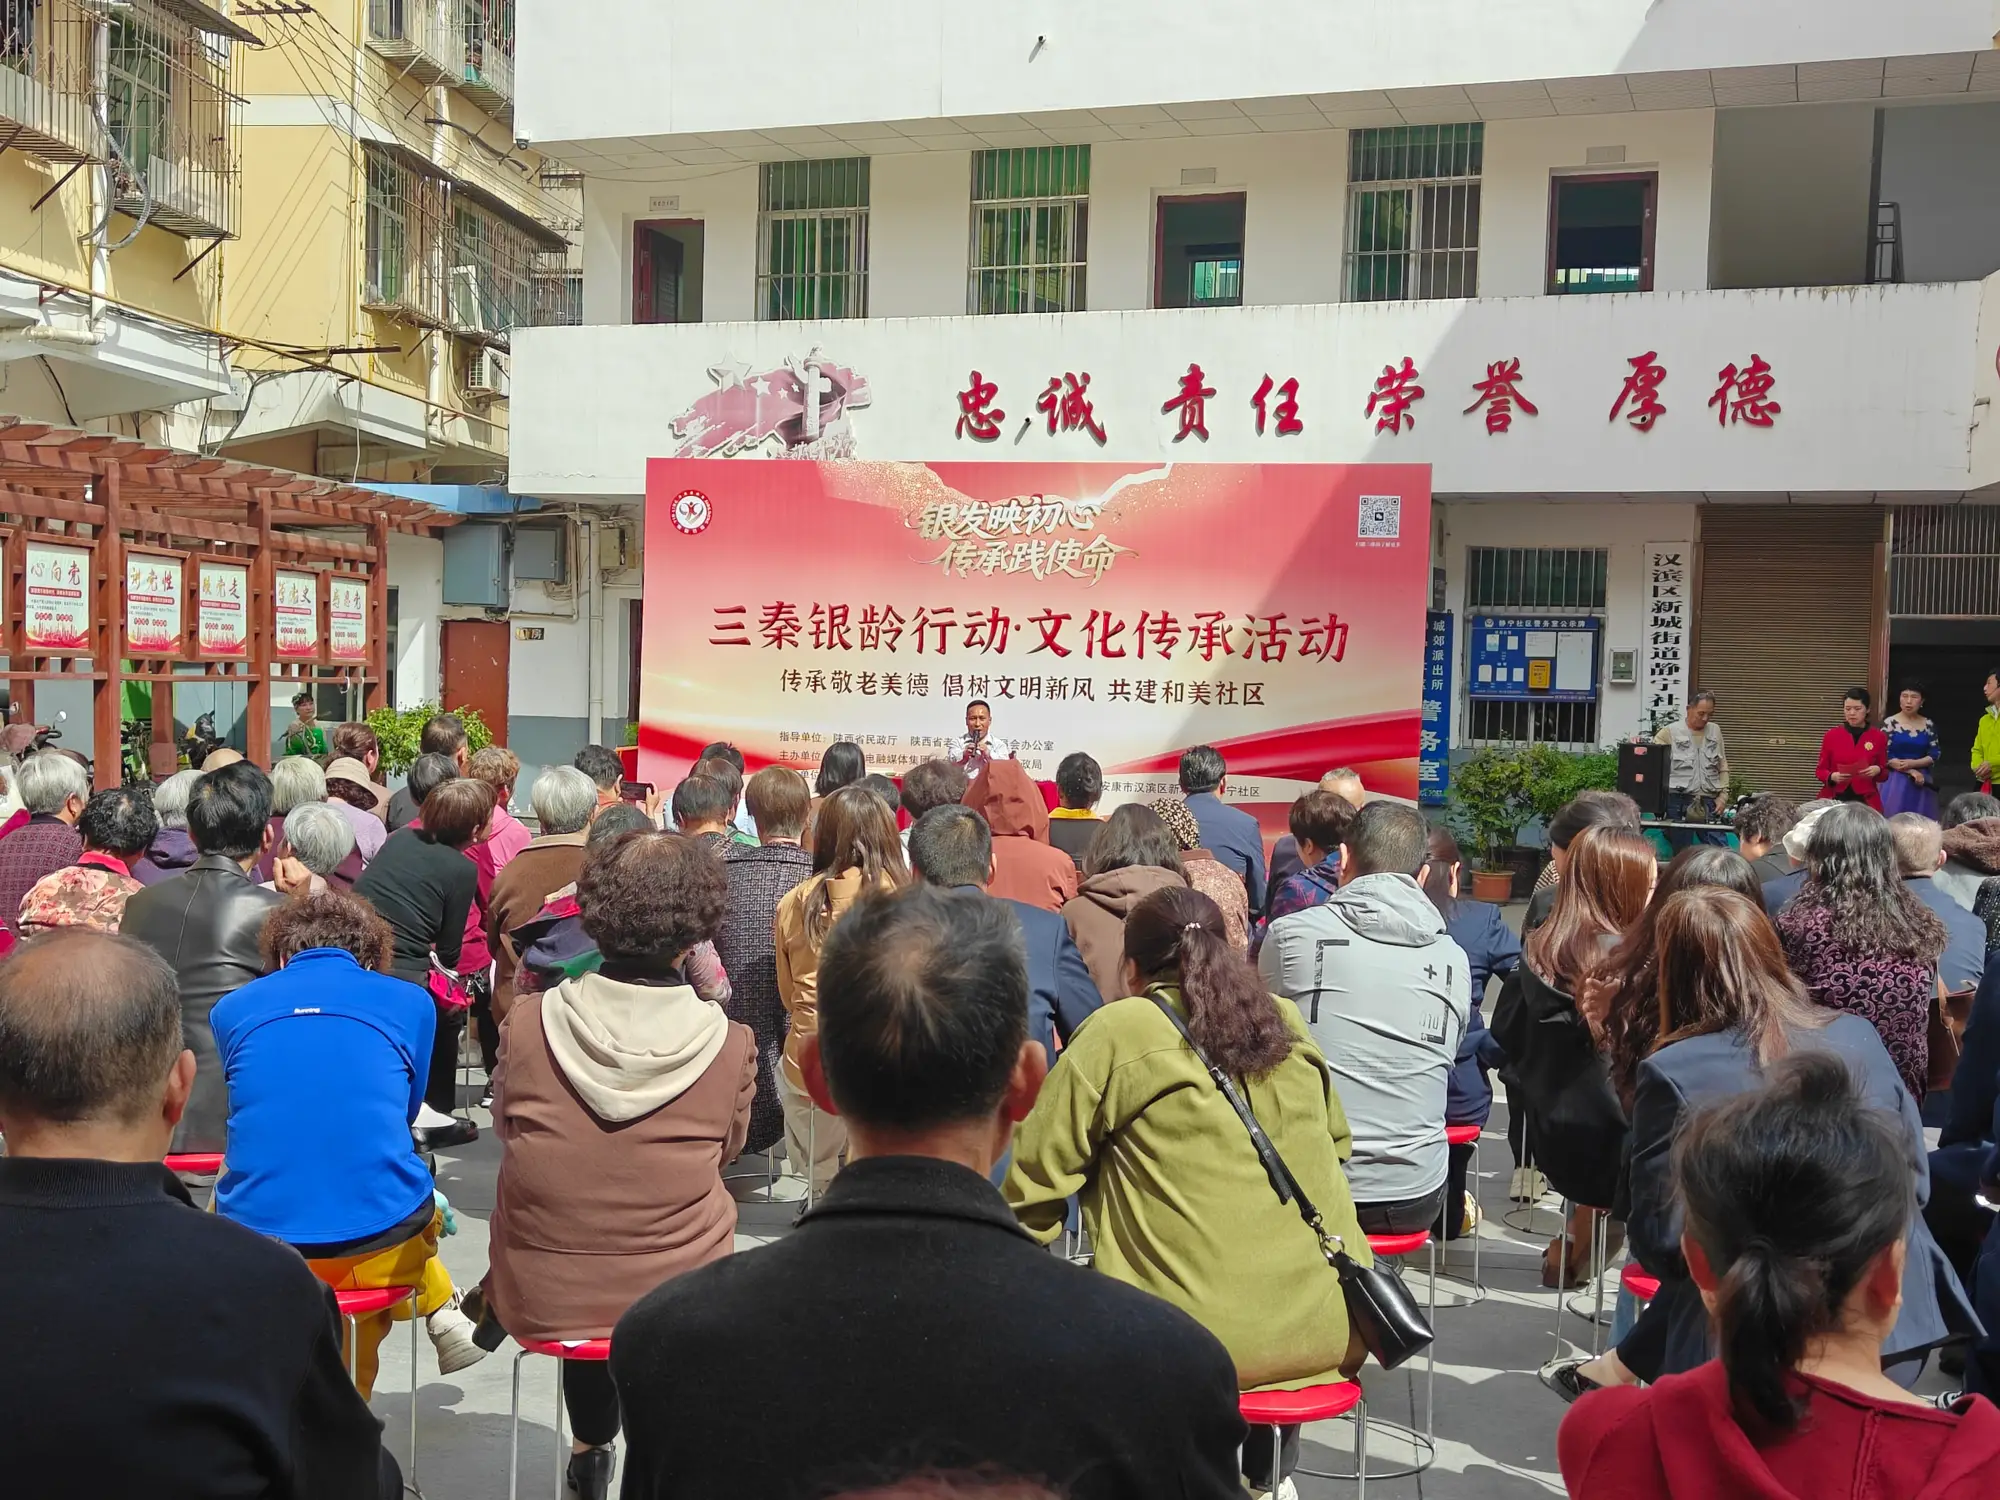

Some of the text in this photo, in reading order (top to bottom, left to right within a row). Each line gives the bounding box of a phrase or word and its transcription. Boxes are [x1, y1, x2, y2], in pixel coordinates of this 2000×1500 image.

[955, 350, 1782, 447] 忠诚 责任 荣誉 厚德
[904, 496, 1105, 541] 银发映初心
[30, 560, 81, 586] 心向党
[920, 533, 1140, 588] 传承践使命
[708, 600, 1350, 664] 三秦银龄行动·文化传承活动
[1431, 619, 1446, 691] 城郊派出所
[780, 669, 1266, 707] 传承敬老美德 倡树文明新风 共建和美社区
[779, 750, 821, 761] 主办单位
[866, 754, 931, 765] 电融媒体集团
[833, 733, 898, 746] 陕西省民政厅
[910, 736, 1054, 751] 陕西省老会办公室
[1419, 699, 1442, 782] 警务室
